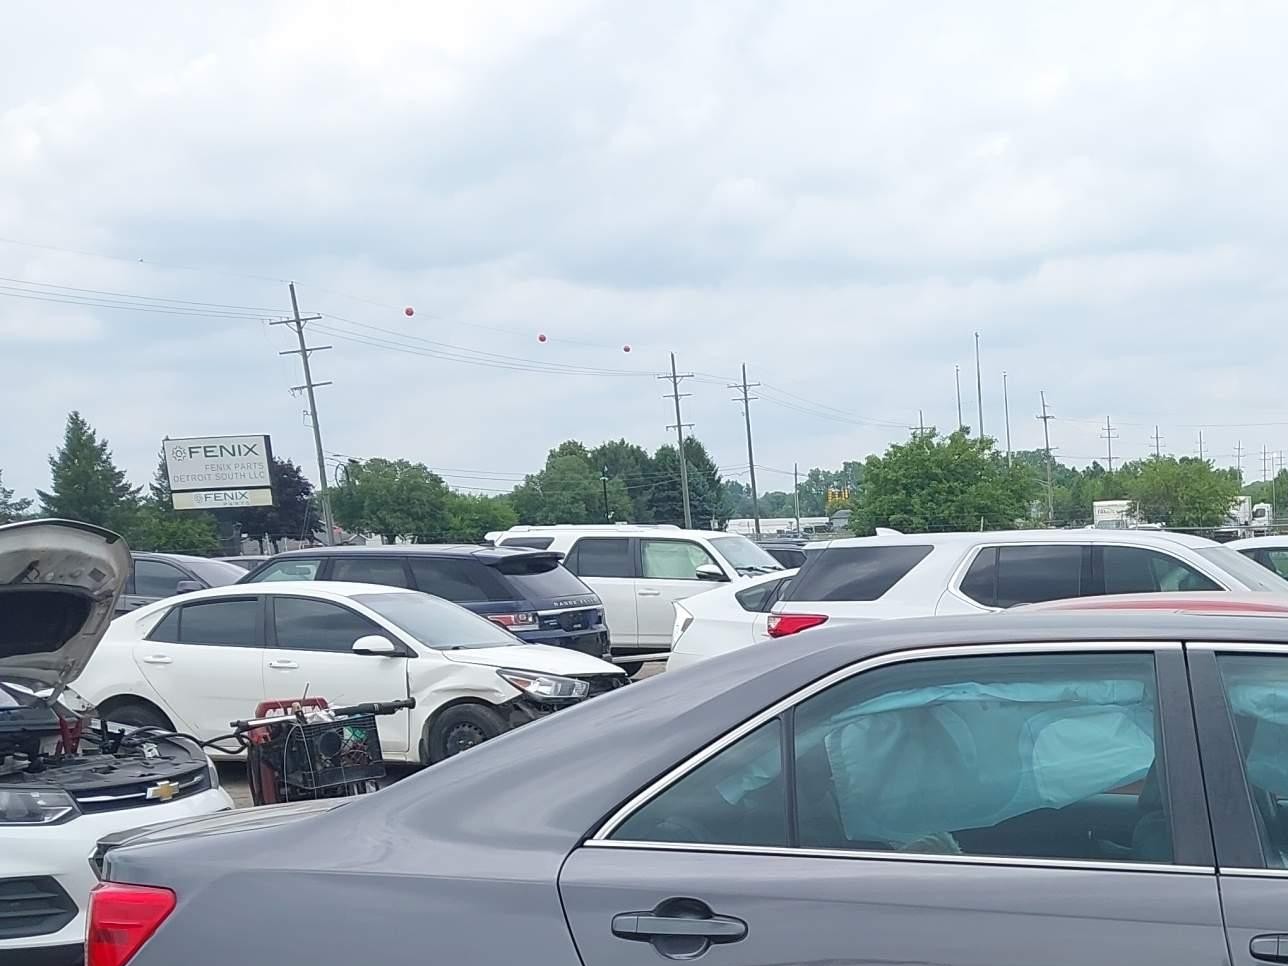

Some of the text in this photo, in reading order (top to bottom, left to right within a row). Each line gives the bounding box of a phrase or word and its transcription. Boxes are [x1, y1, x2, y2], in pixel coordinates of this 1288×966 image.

[188, 444, 259, 459] FENIX
[204, 462, 265, 472] FENIX PARTS
[173, 471, 265, 483] DETROIT SOUTH LLC
[204, 491, 249, 502] FENIX
